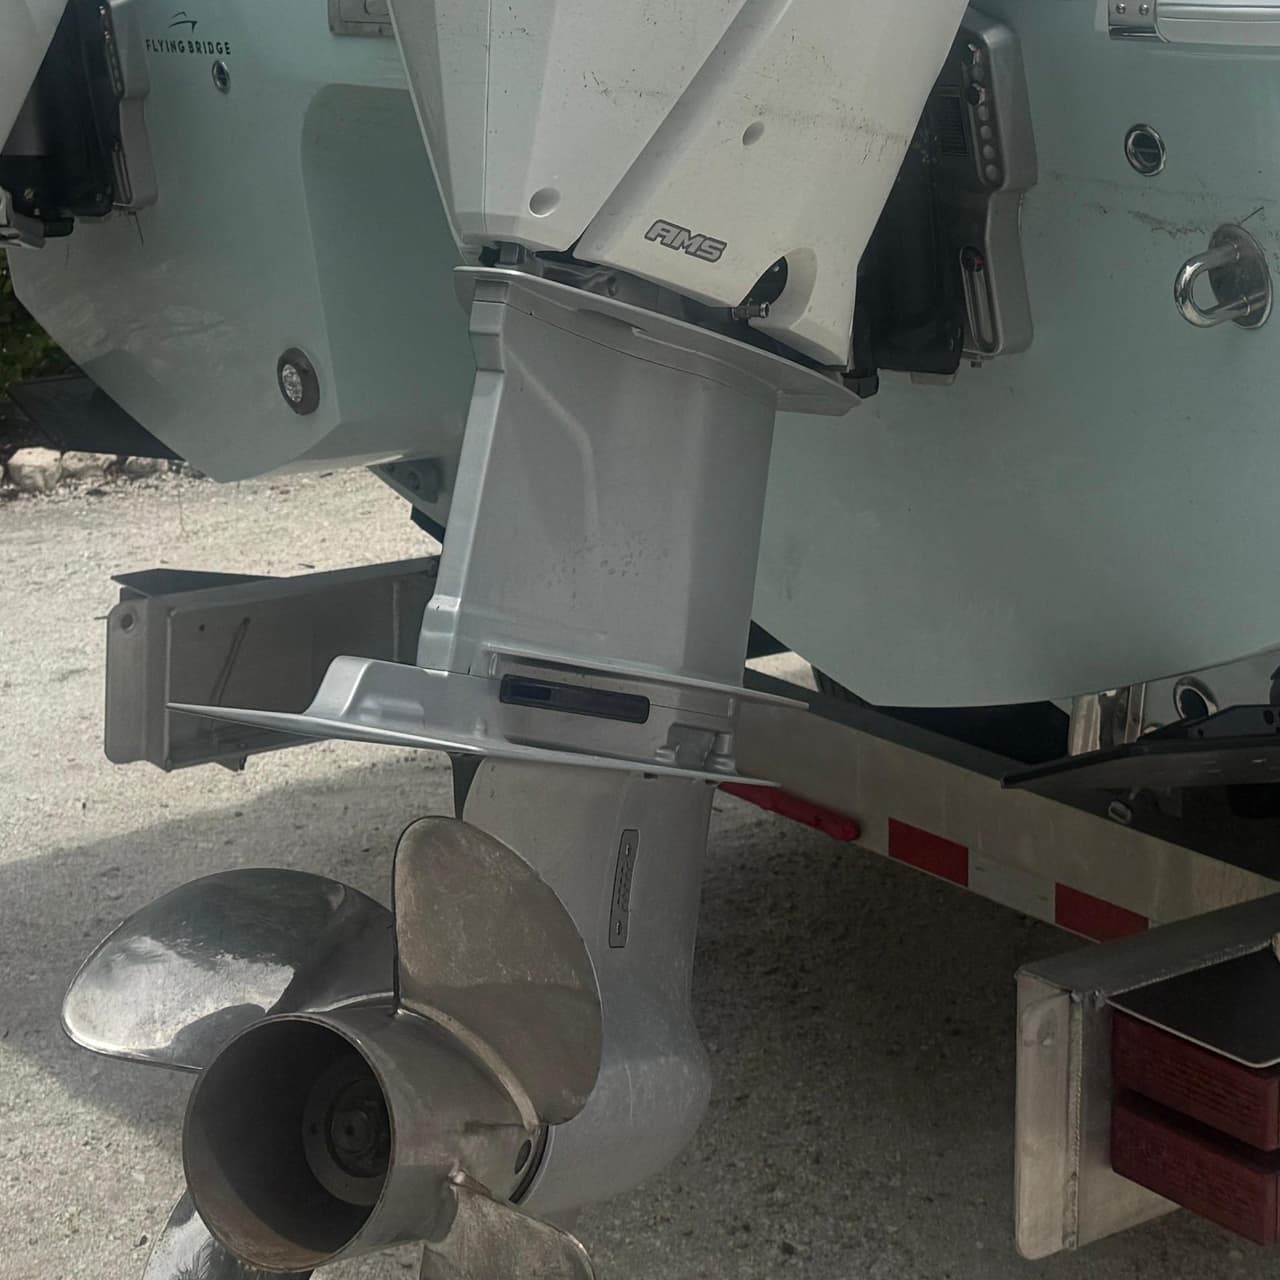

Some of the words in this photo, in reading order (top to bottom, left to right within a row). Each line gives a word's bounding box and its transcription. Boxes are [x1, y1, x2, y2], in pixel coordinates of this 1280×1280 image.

[145, 39, 185, 54] FLYING
[186, 40, 231, 55] BRIDGE
[644, 219, 728, 263] AMS
